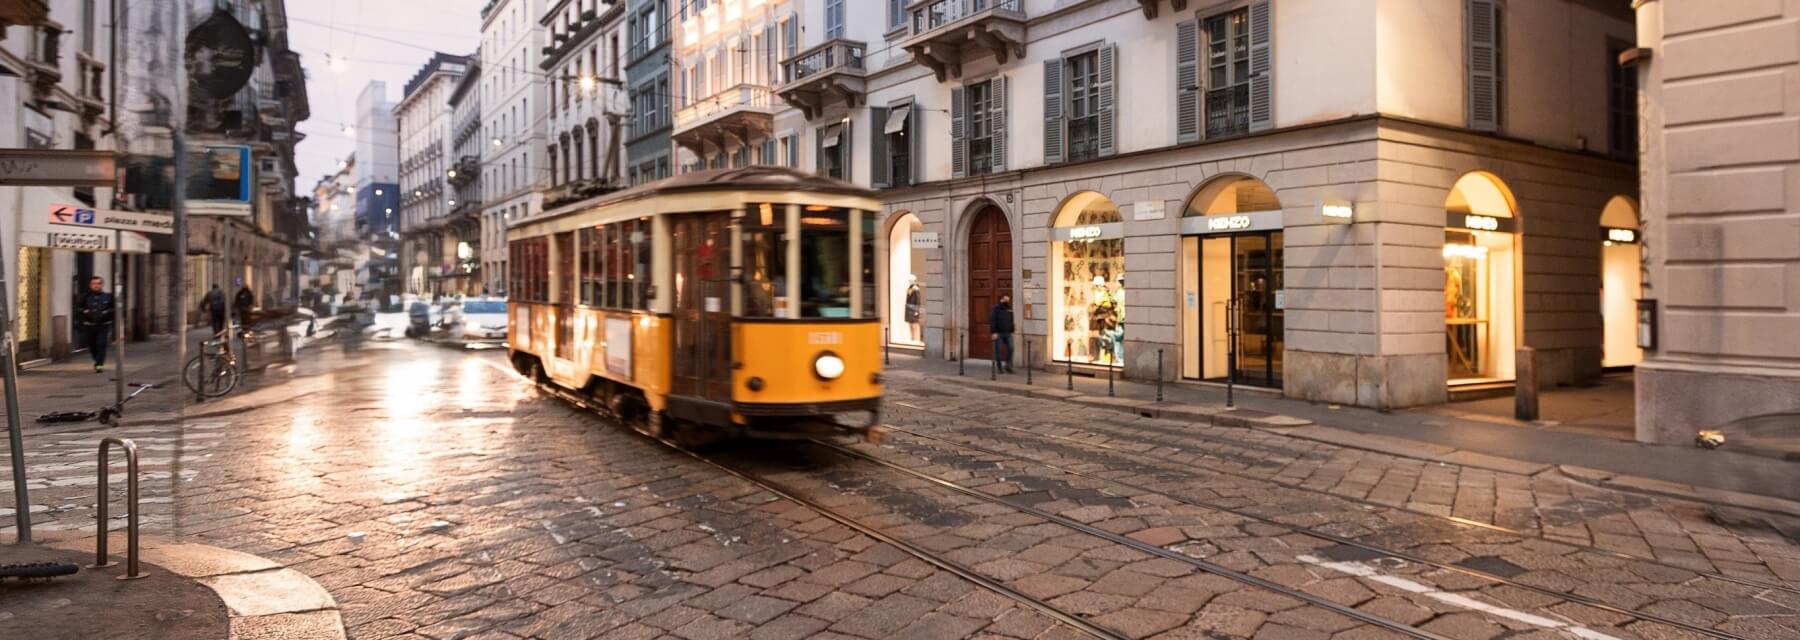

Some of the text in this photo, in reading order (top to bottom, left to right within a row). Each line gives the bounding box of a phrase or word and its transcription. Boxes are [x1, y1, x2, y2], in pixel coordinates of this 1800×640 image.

[104, 215, 138, 226] piazza
[1208, 215, 1250, 230] KENZO
[1070, 226, 1101, 238] KENZO
